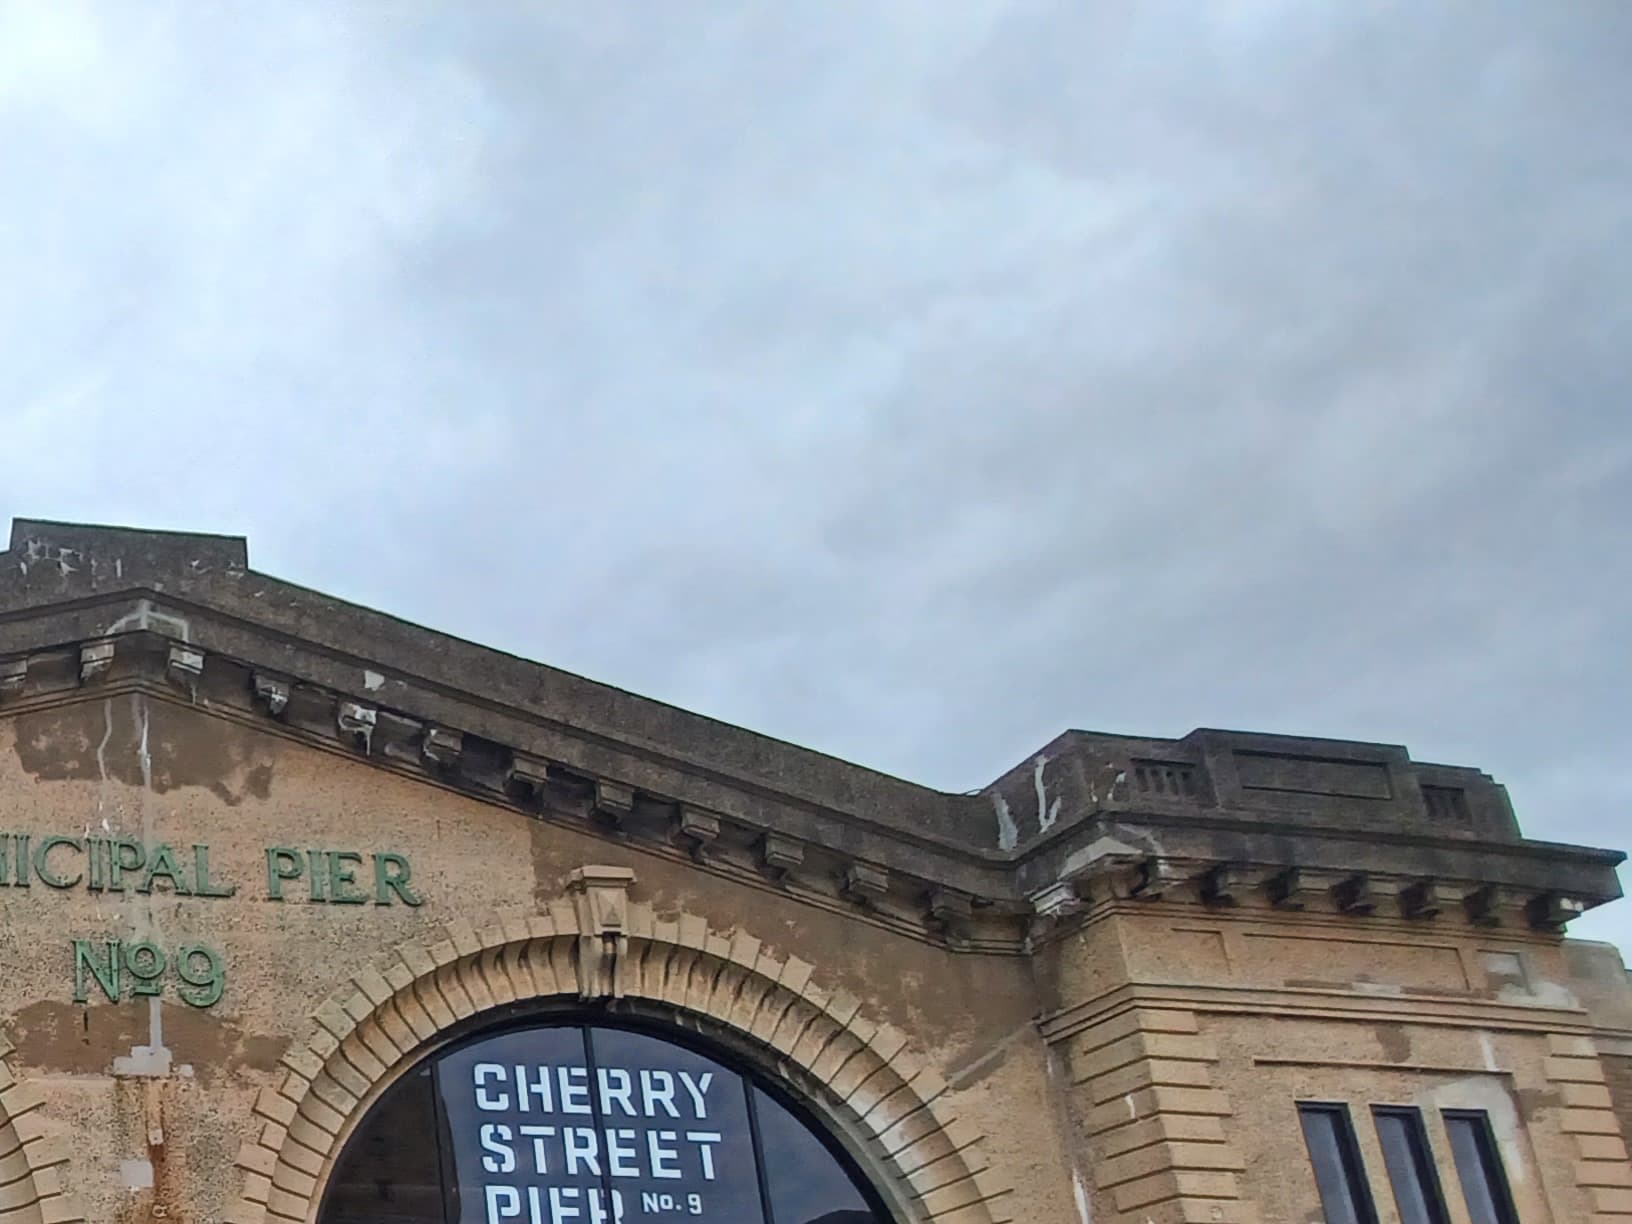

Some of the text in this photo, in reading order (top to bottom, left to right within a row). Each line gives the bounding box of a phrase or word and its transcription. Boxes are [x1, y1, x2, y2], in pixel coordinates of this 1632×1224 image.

[266, 846, 423, 907] PIER
[473, 1063, 713, 1119] CHERRY
[480, 1123, 721, 1180] STREET
[687, 1194, 703, 1215] 9
